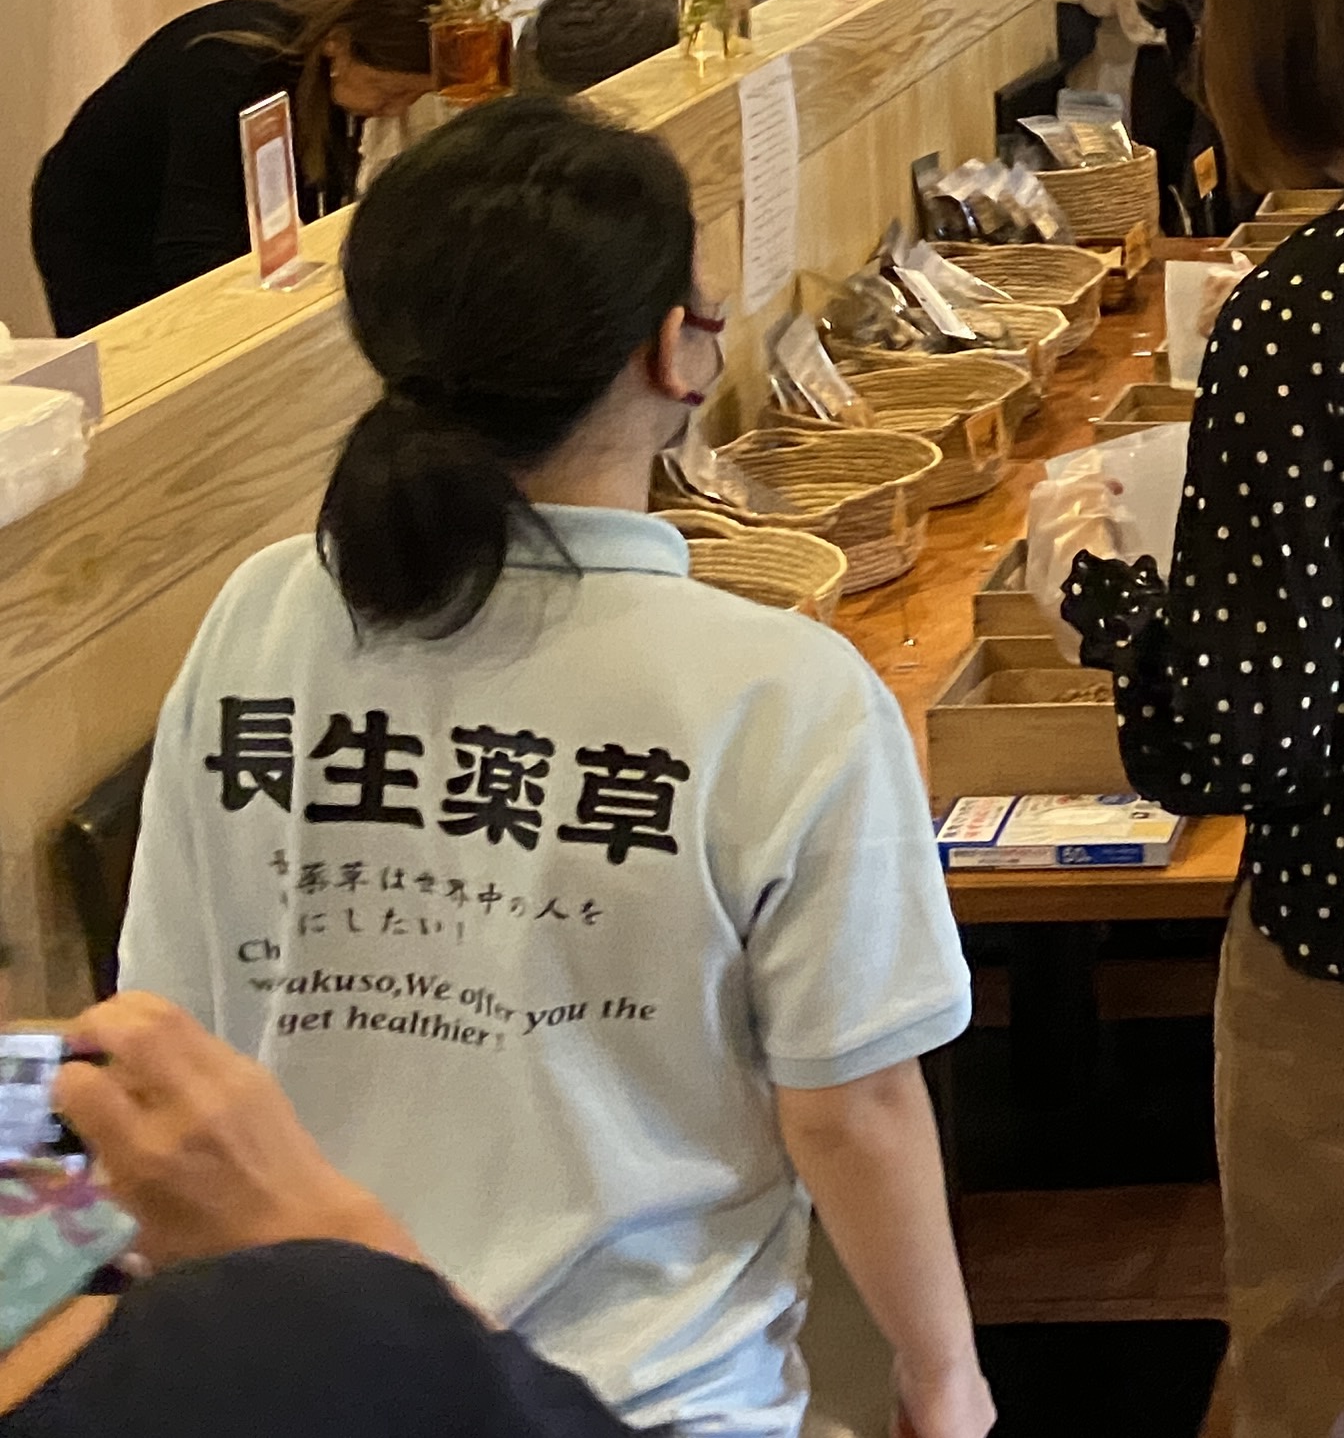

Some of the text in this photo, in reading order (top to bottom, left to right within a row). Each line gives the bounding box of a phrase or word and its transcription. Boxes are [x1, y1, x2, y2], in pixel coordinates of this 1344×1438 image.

[204, 694, 690, 865] 長生薬草
[276, 1008, 334, 1036] get
[523, 1000, 587, 1037] you
[601, 996, 657, 1021] the
